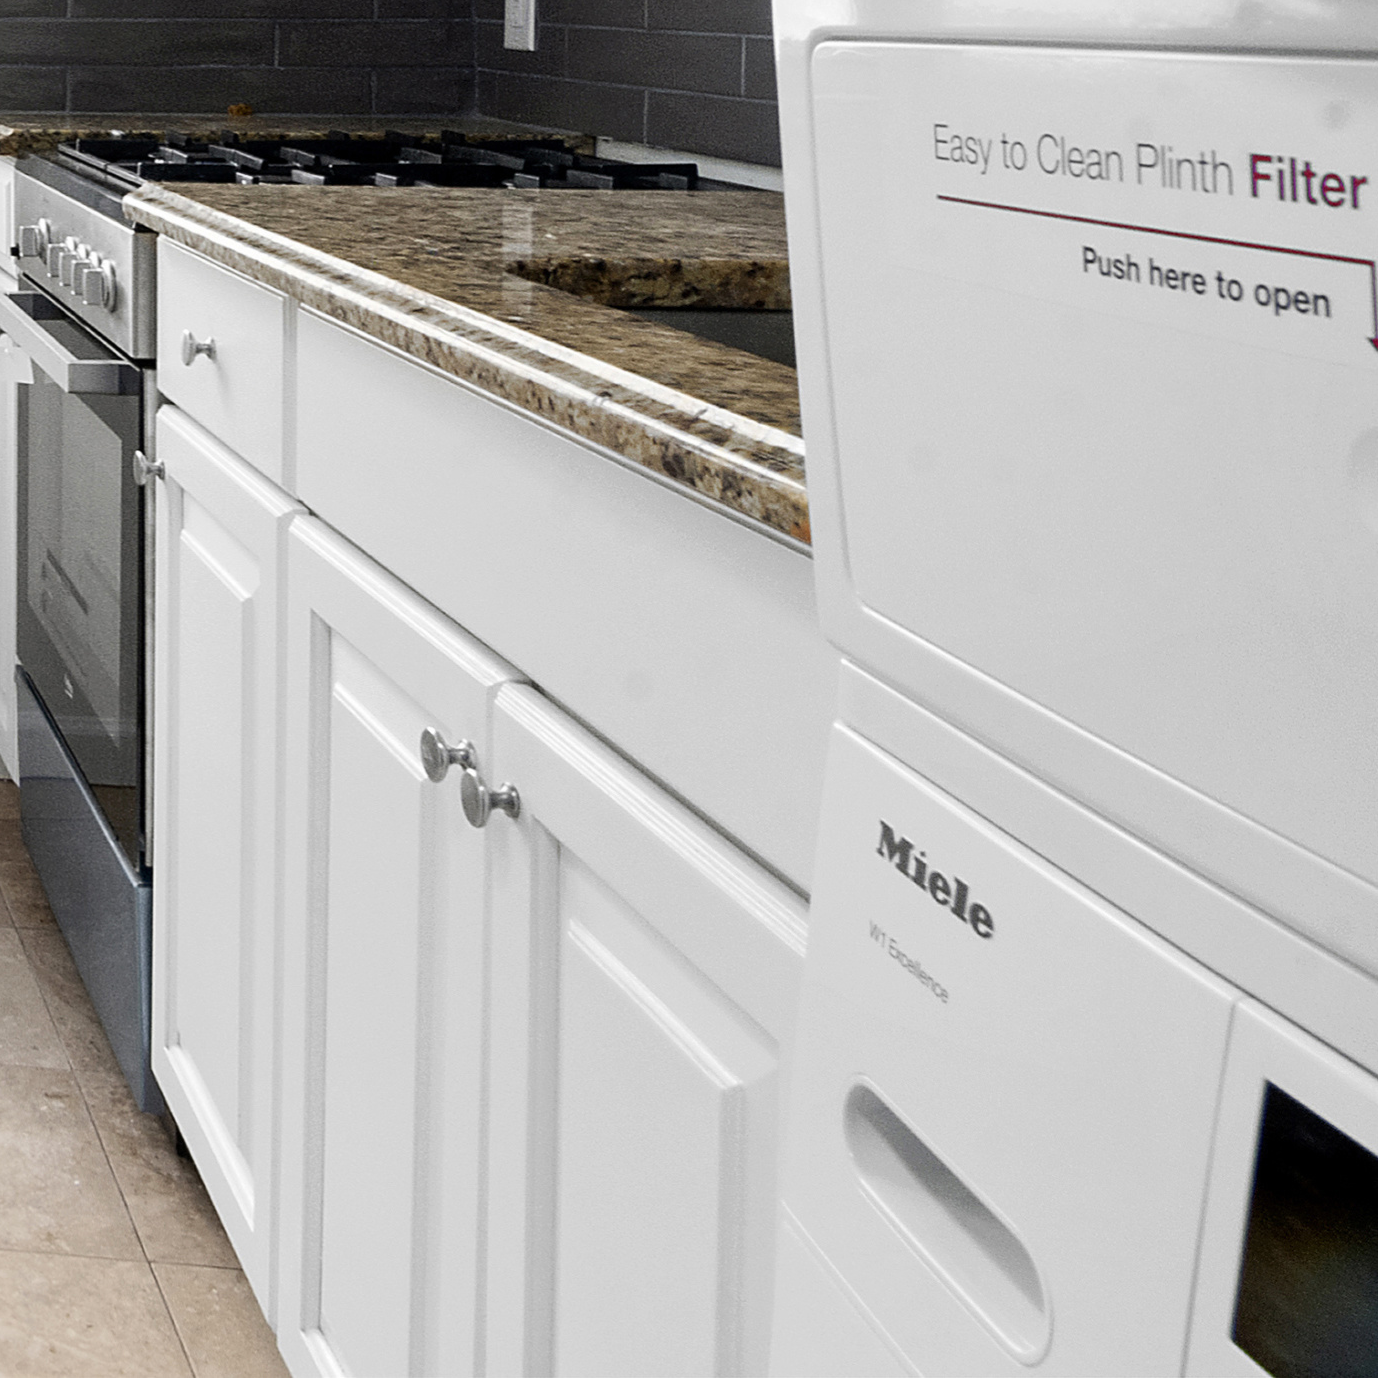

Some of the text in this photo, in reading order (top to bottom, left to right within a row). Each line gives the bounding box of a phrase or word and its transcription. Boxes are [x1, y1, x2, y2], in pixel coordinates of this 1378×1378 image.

[933, 123, 1370, 211] Easy to Clean Plinth Filter
[1081, 245, 1333, 319] Push here to open
[875, 819, 996, 941] Miele
[888, 936, 949, 1004] Excellence
